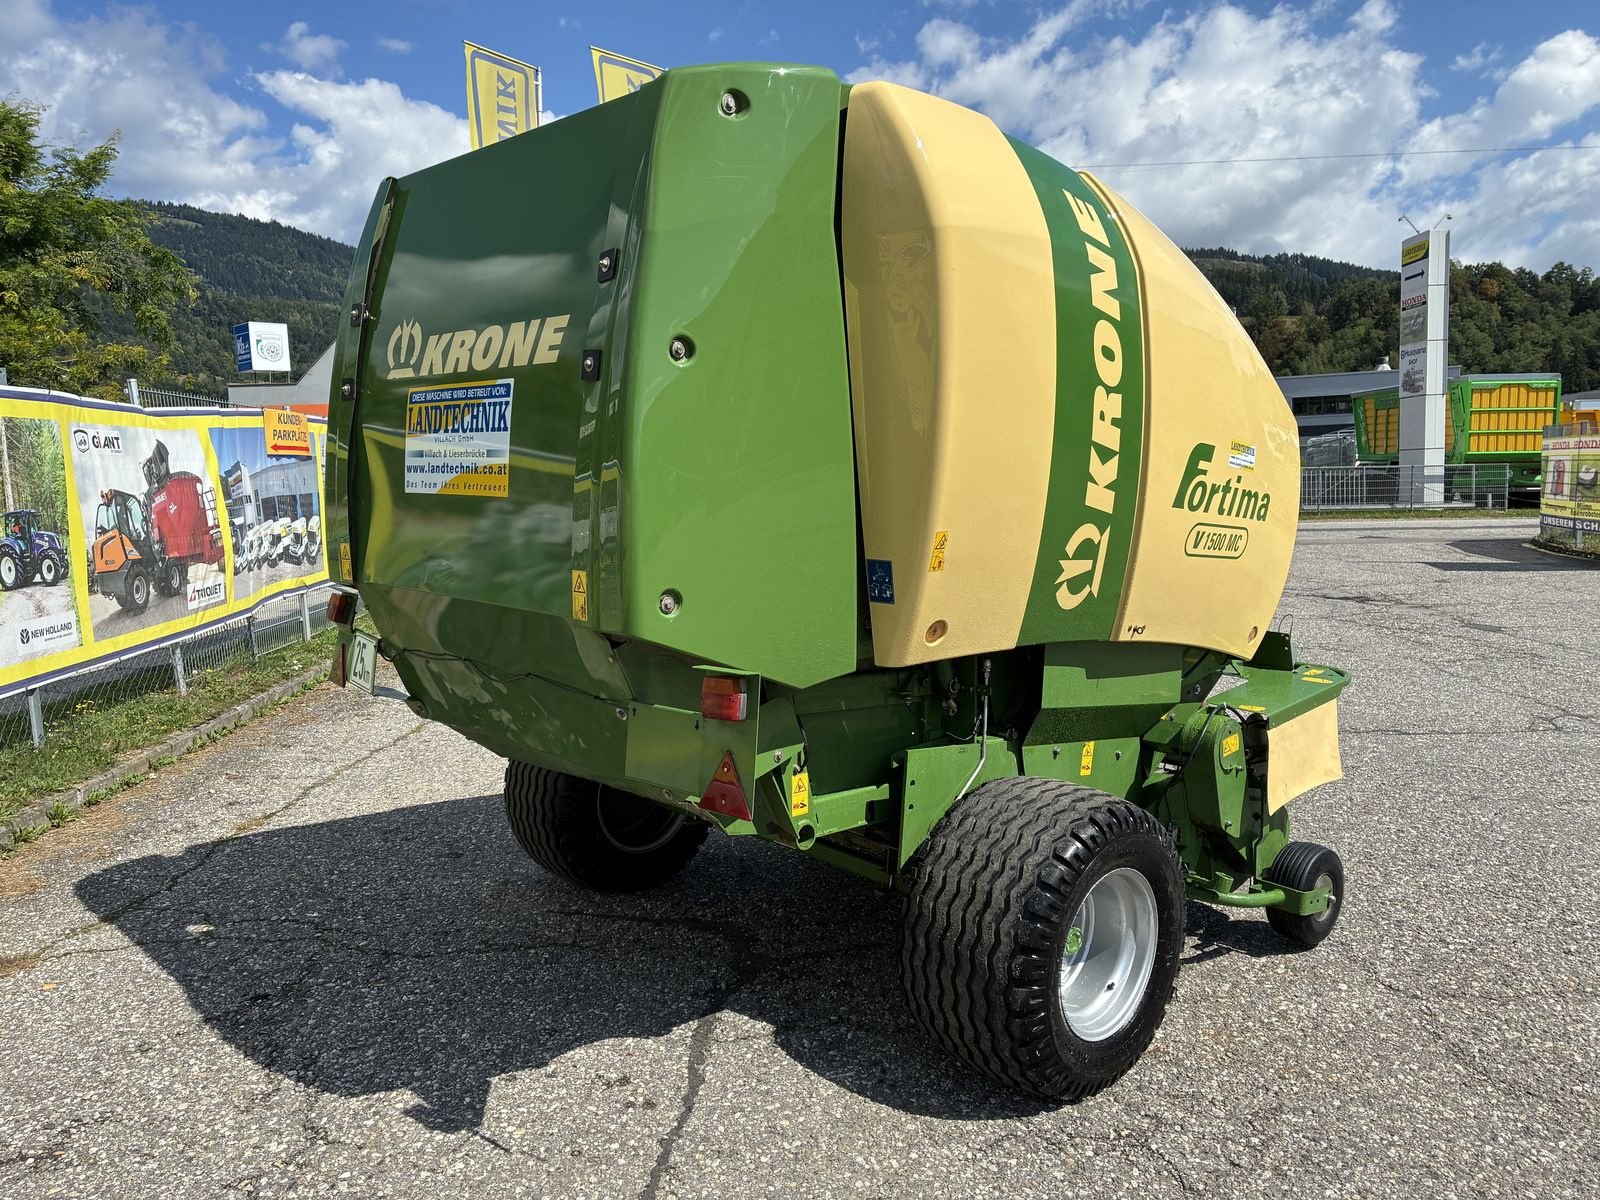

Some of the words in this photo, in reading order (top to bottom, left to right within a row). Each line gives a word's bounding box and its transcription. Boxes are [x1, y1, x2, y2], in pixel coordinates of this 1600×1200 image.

[1402, 294, 1426, 306] HONDA
[419, 314, 570, 376] KRONE
[1062, 187, 1123, 514] KRONE
[412, 392, 426, 402] DIESE
[426, 390, 452, 400] MASCHINE
[453, 390, 466, 398] WIRD
[468, 388, 490, 398] BETREUT
[492, 386, 507, 396] VON:
[408, 400, 510, 434] LANDTECHNIK
[424, 449, 442, 458] Villach
[444, 450, 447, 458] &
[449, 449, 485, 458] Lieserbrücke
[406, 462, 507, 475] www.landtechnik.co.at
[441, 481, 460, 489] Ihres
[464, 482, 506, 492] Vertrauens
[1172, 442, 1270, 522] Fortima
[1544, 516, 1573, 528] UNSEREN
[1192, 530, 1206, 549] V
[1203, 532, 1226, 551] 1500
[1225, 534, 1242, 552] MC
[31, 628, 44, 639] NEW
[45, 622, 72, 636] HOLLAND
[353, 640, 367, 680] 25
